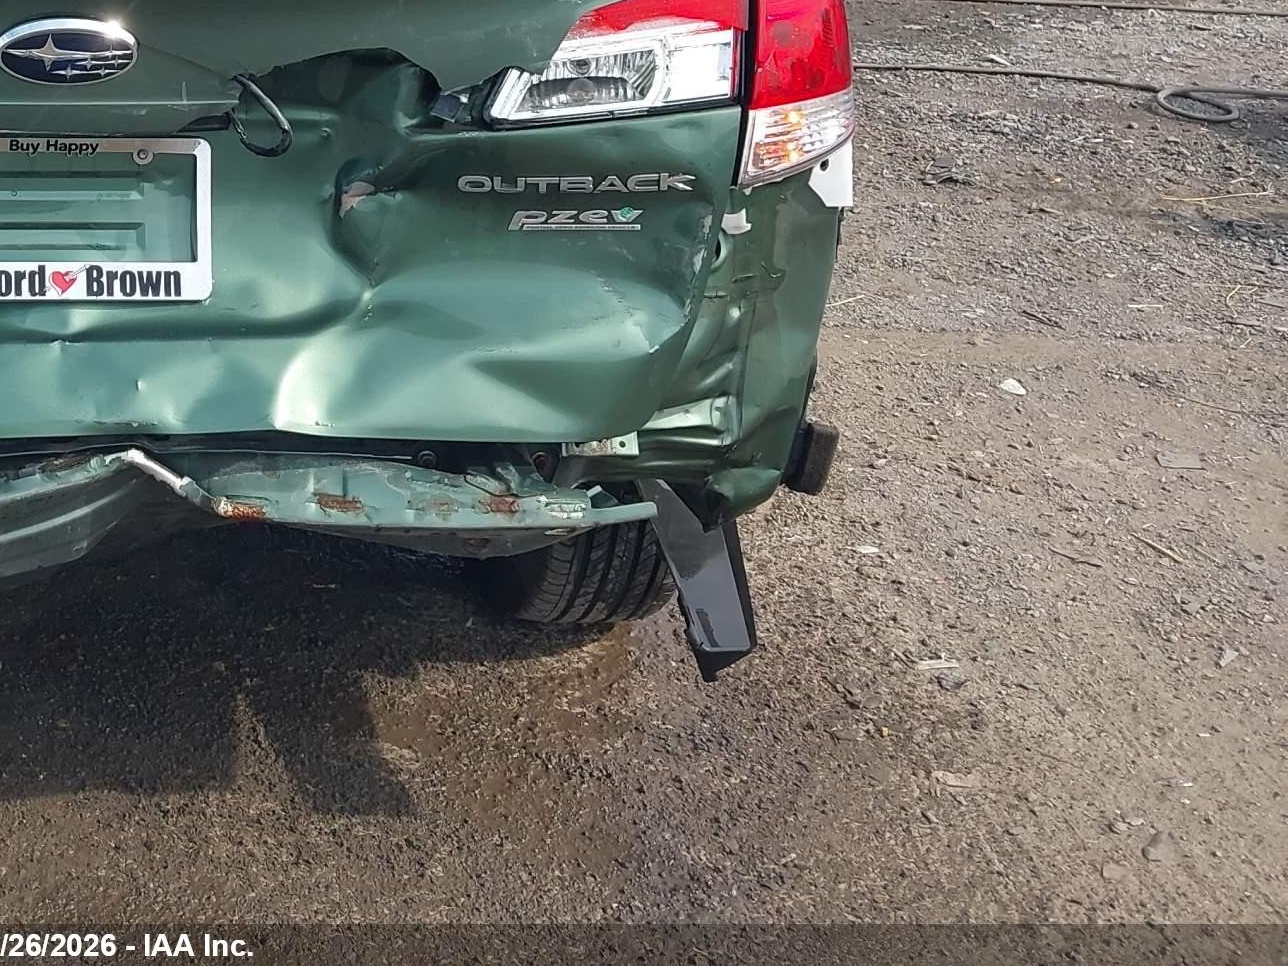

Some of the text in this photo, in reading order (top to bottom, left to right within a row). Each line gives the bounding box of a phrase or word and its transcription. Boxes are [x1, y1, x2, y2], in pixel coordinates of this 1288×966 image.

[9, 139, 99, 155] Buy Happy
[457, 172, 696, 193] OUTBACK
[86, 264, 182, 298] Brown
